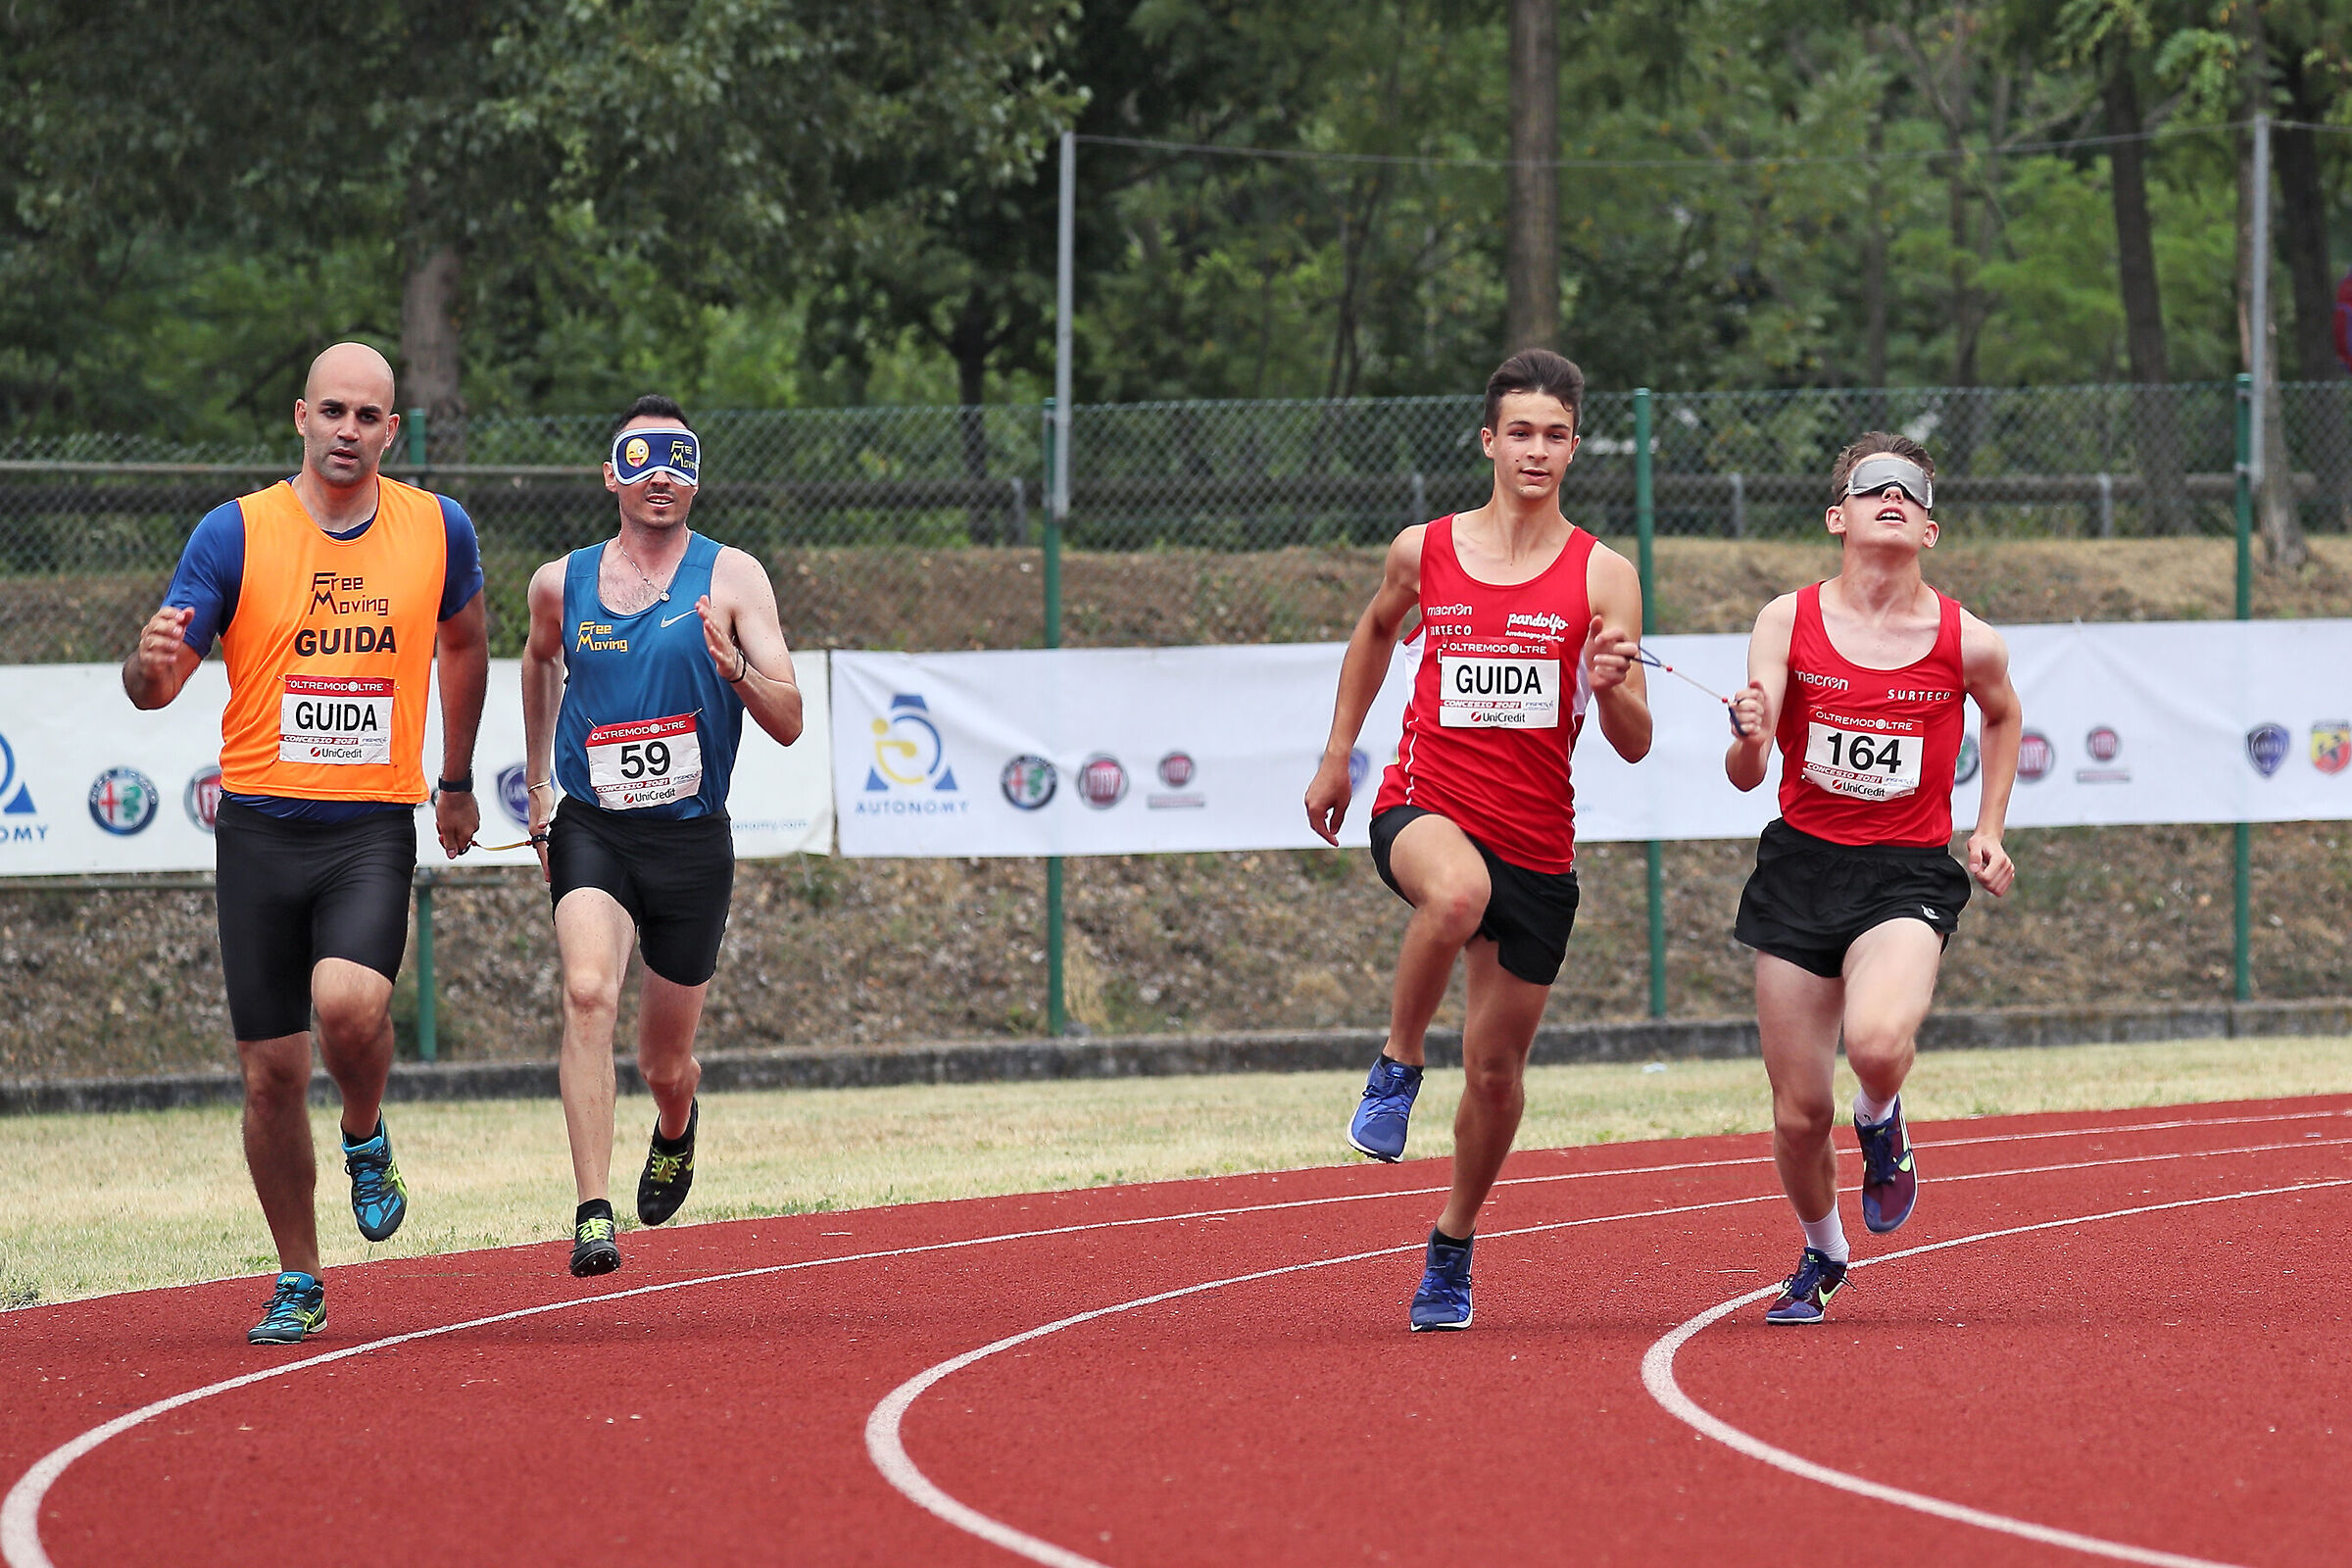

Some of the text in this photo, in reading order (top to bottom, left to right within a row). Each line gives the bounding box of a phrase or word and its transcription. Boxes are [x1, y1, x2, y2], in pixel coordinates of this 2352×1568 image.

[311, 571, 364, 592] Free
[309, 589, 389, 616] Moving
[577, 620, 612, 636] Free
[1506, 612, 1569, 635] pandolfo
[294, 625, 397, 657] GUIDA
[575, 633, 629, 653] Moving
[1449, 642, 1547, 655] OLTREMODOLTRE
[290, 680, 384, 693] OLTREMODOLTRE
[1455, 664, 1543, 695] GUIDA
[1886, 688, 1951, 702] SURTECO
[295, 701, 378, 732] GUIDA
[1482, 711, 1526, 723] UniCredit
[1815, 710, 1913, 731] OLTREMODOLTRE
[591, 720, 687, 741] OLTREMODOLTRE
[321, 748, 363, 760] UniCredit
[620, 741, 671, 780] 59
[1827, 732, 1902, 774] 164
[634, 787, 676, 803] UniCredit
[1842, 781, 1886, 798] UniCredit
[856, 799, 970, 816] AUTONOMY
